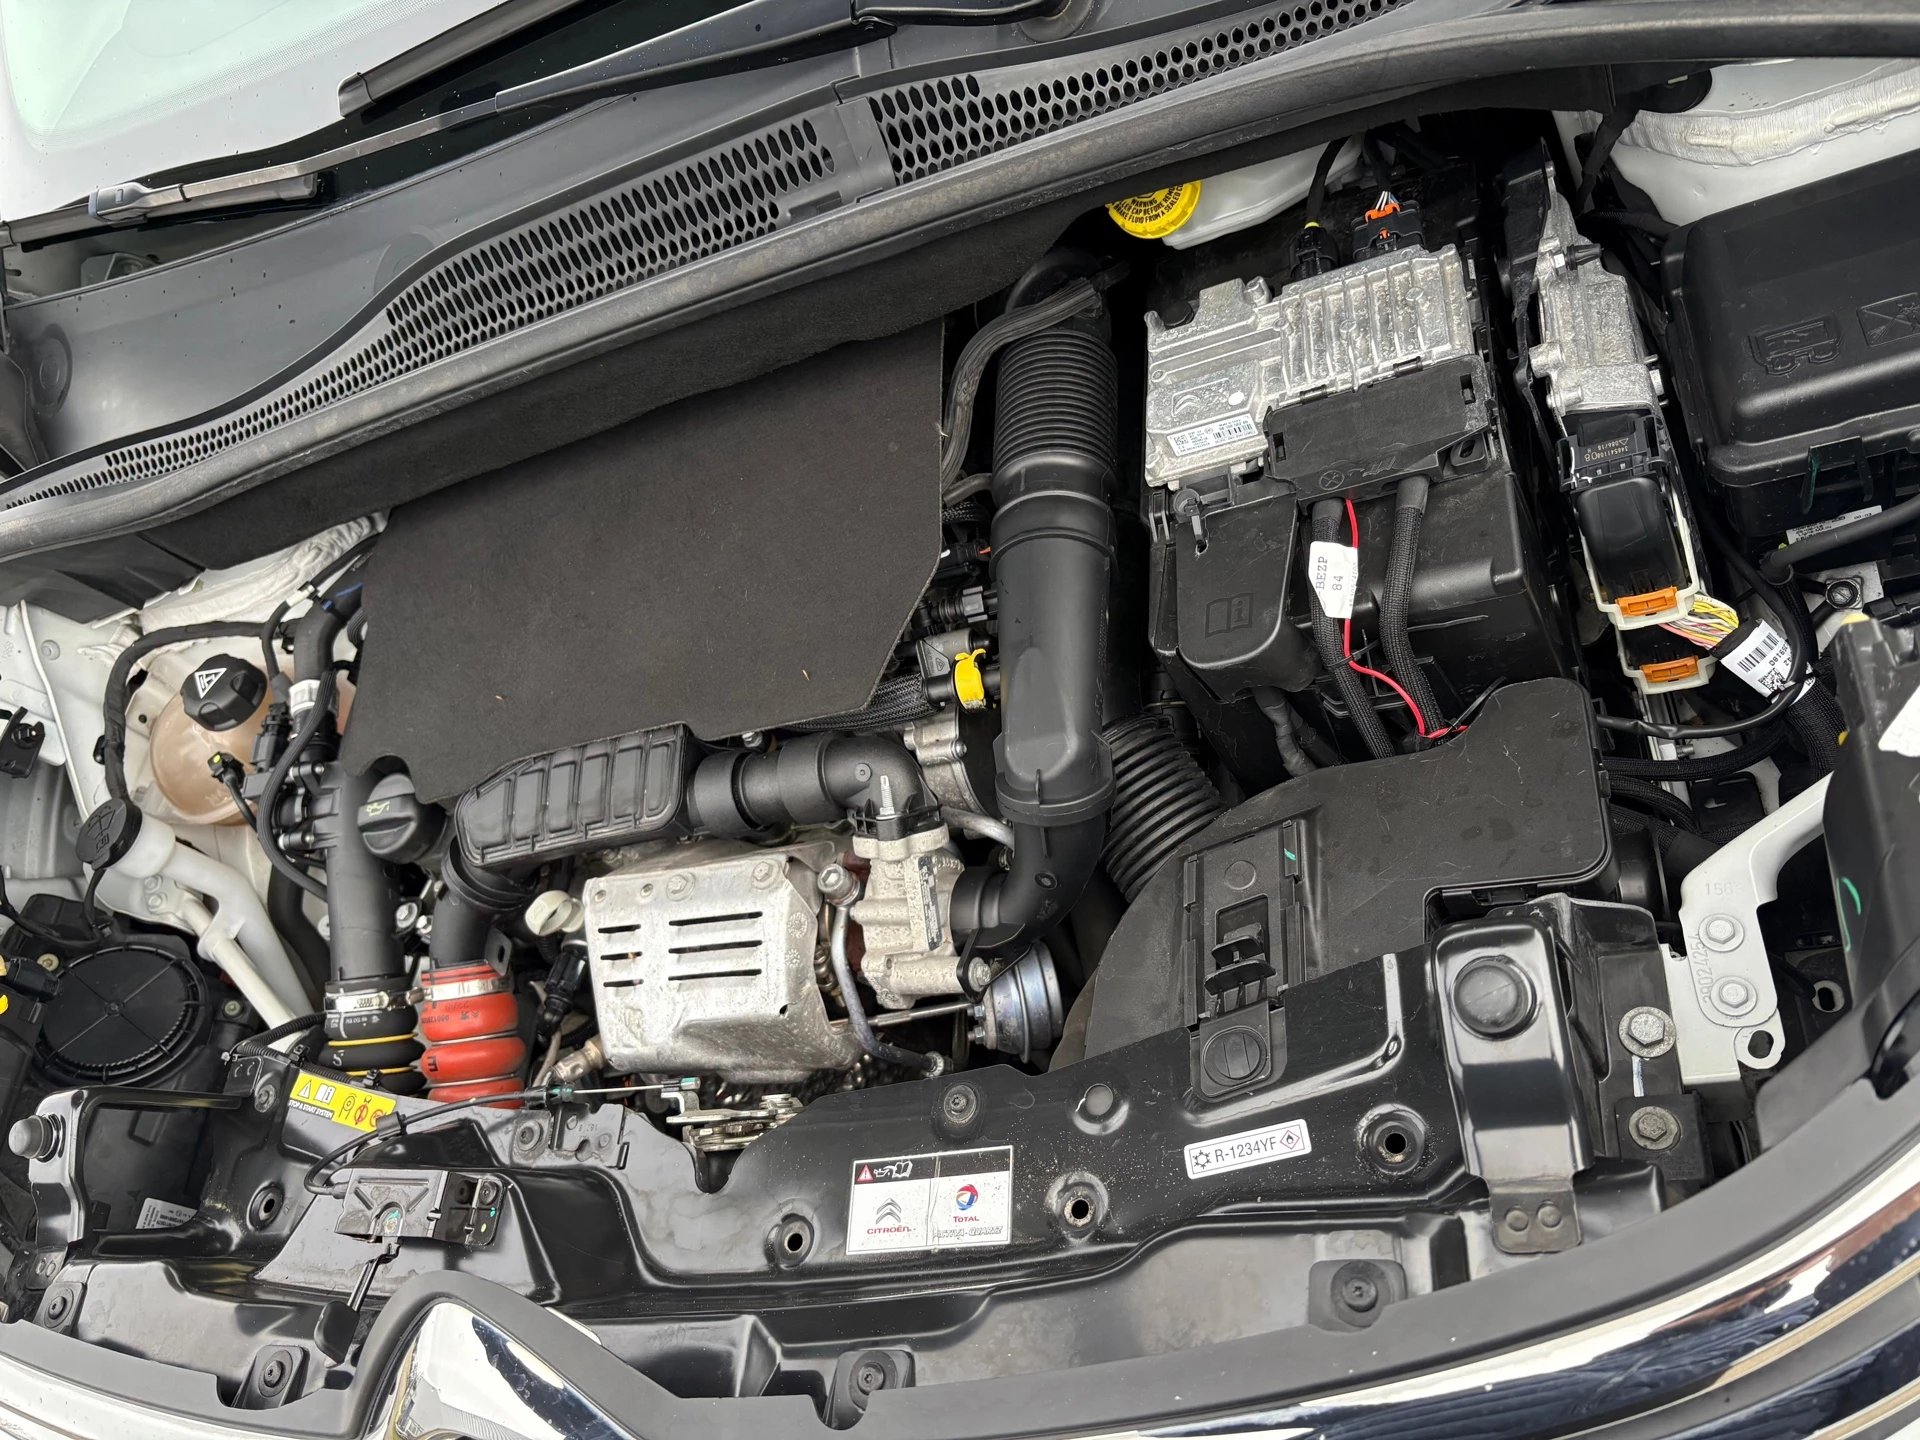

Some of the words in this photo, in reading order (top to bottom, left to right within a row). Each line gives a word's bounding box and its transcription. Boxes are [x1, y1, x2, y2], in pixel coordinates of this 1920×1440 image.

[1114, 204, 1129, 220] BRAKE
[1128, 214, 1144, 224] FLUID
[1145, 212, 1161, 223] FROM
[1164, 192, 1181, 213] SEALED
[1131, 198, 1157, 208] WARNING
[1131, 207, 1142, 215] CAP
[1143, 201, 1164, 215] BEFORE
[1332, 576, 1343, 591] 84
[288, 1100, 299, 1109] STOP
[303, 1104, 316, 1113] START
[316, 1107, 333, 1119] SYSTEM
[1214, 1136, 1277, 1163] R-1234YF
[953, 1215, 979, 1223] TOTAL
